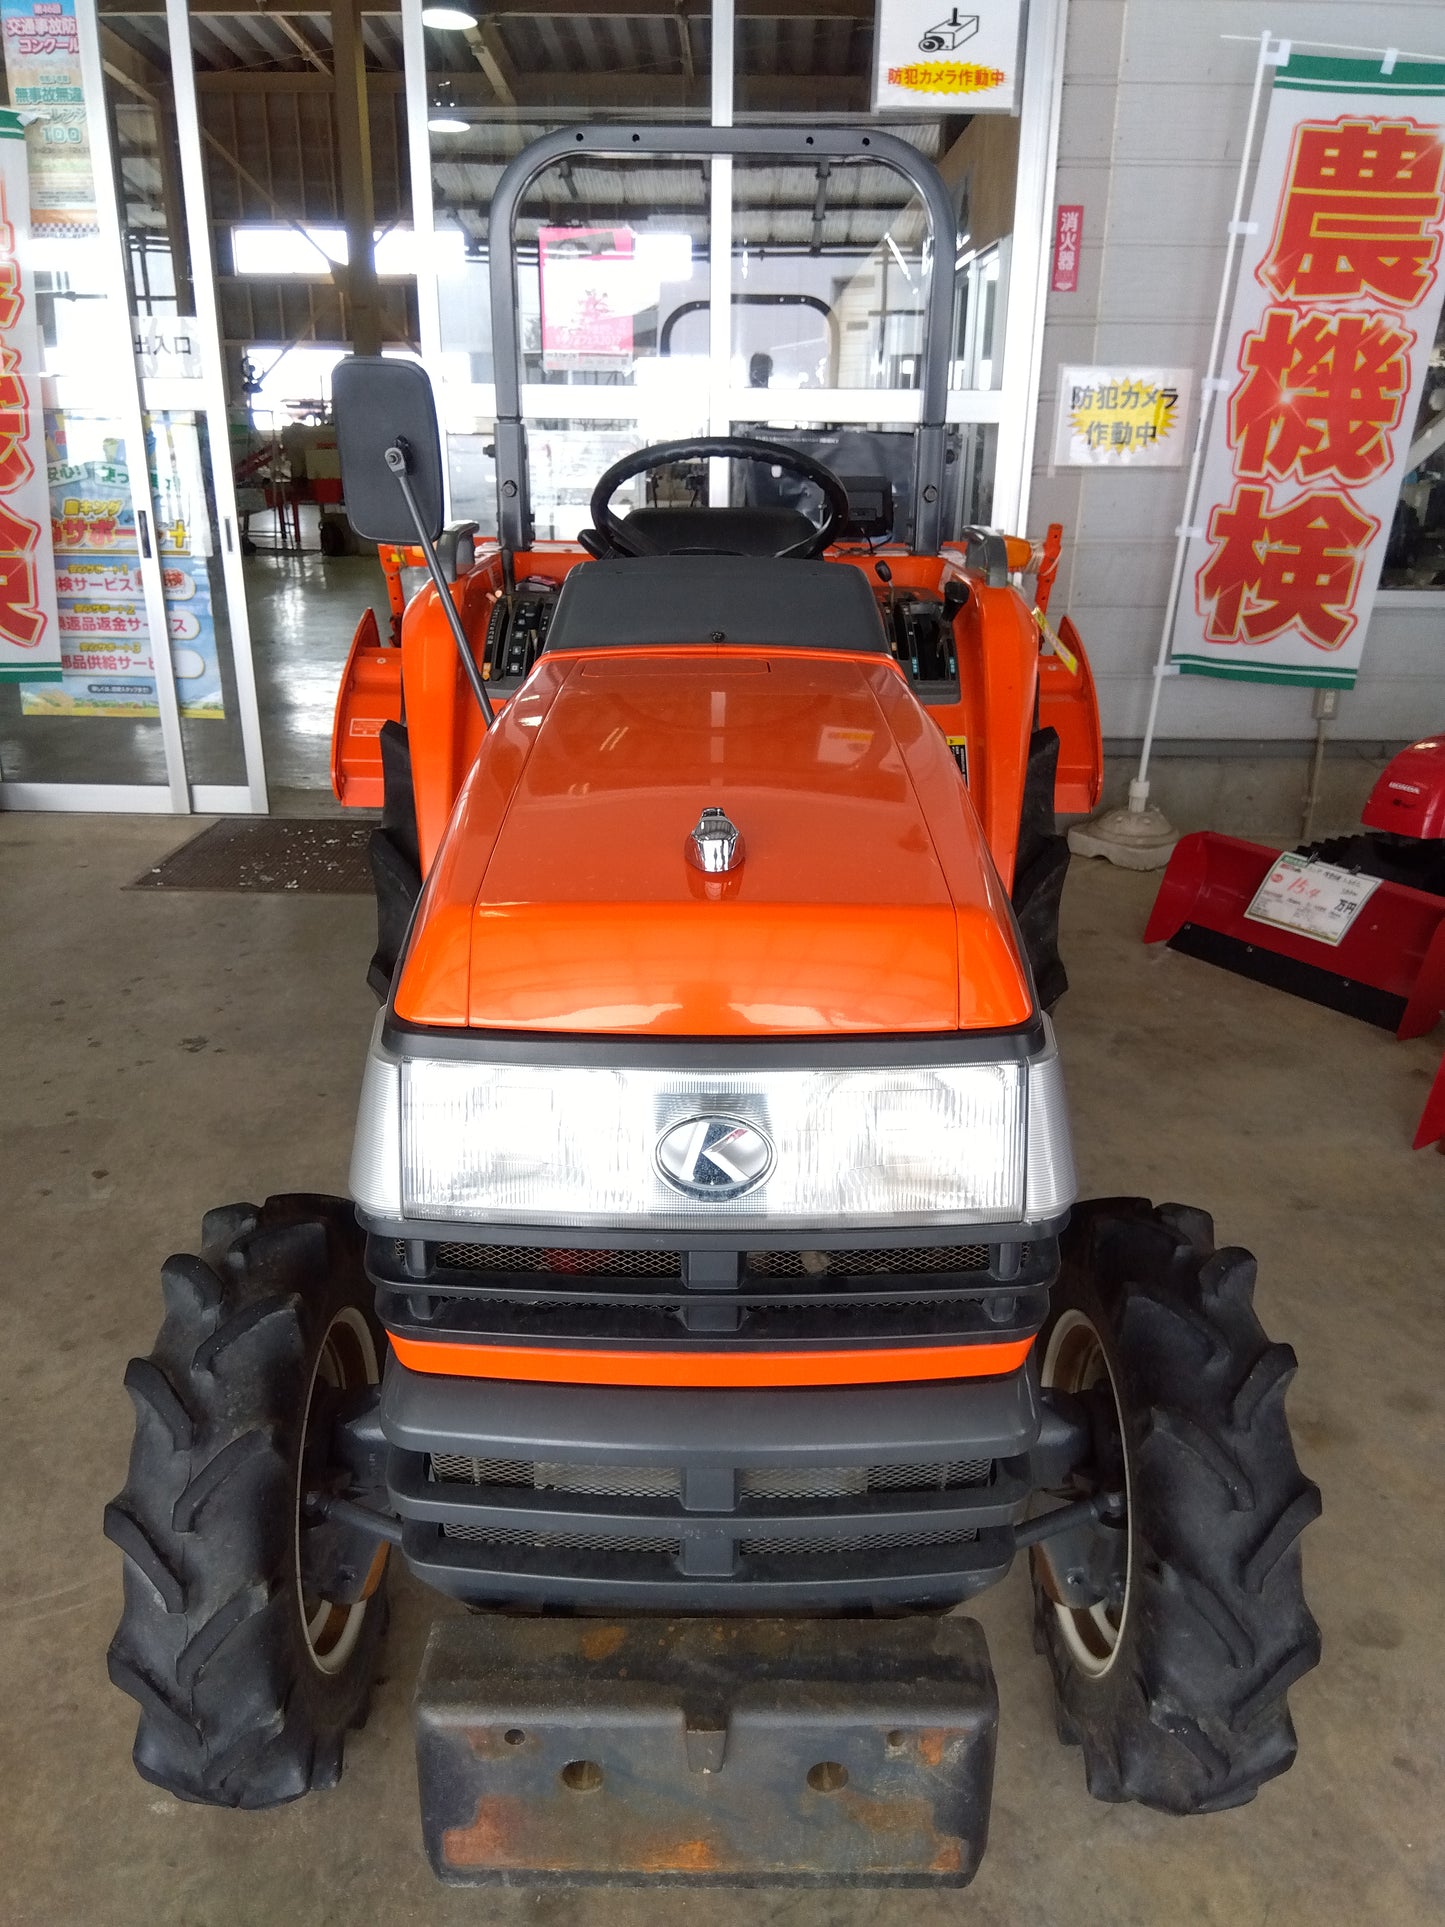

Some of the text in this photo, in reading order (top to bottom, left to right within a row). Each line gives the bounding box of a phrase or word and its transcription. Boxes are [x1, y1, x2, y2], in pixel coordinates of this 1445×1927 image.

[19, 37, 79, 54] コンクール
[887, 68, 1005, 86] 防犯カメラ作動中
[42, 126, 81, 144] 100
[1058, 211, 1079, 271] 消火器
[134, 334, 191, 355] 出入口
[1200, 119, 1445, 648] 農機検
[1071, 385, 1179, 410] 防犯カメラ
[1085, 421, 1157, 446] 作動中
[57, 577, 134, 592] 検サービス
[1334, 898, 1358, 915] 万円
